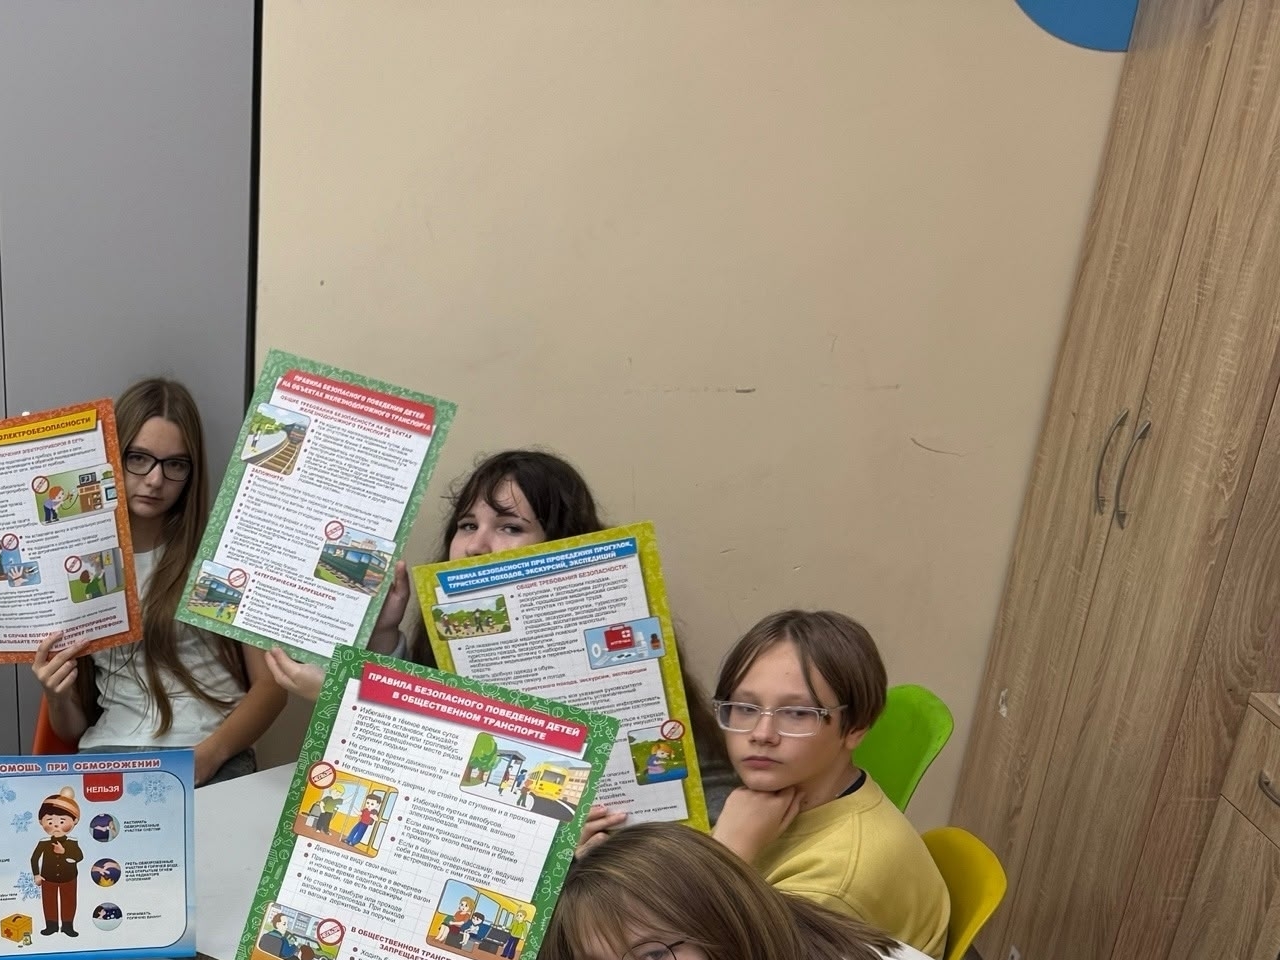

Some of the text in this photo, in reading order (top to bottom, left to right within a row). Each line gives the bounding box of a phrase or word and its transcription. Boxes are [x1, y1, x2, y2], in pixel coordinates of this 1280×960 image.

[367, 672, 580, 736] ПРАВИЛА БЕЗОПАСНОГО ПОВЕДЕНИЯ ДЕТЕЙ
[391, 691, 546, 740] В ОБЩЕСТВЕННОМ ТРАНСПОРТЕ
[46, 761, 69, 772] ПРИ
[73, 758, 160, 771] ОБМОРОЖЕНИИ
[86, 785, 119, 793] НЕЛЬЗЯ
[357, 928, 420, 954] ОБЩЕСТВЕННОМ
